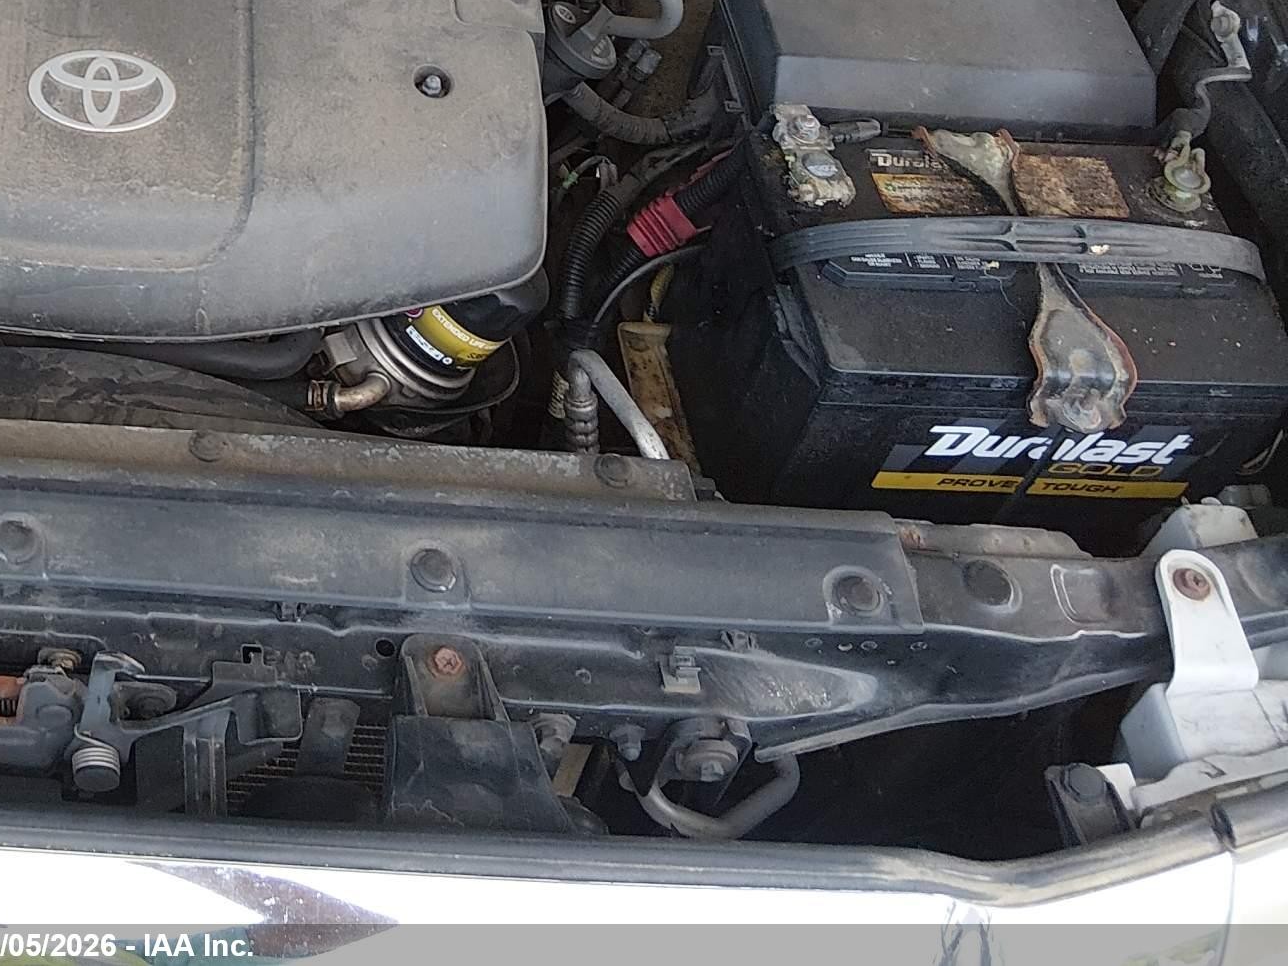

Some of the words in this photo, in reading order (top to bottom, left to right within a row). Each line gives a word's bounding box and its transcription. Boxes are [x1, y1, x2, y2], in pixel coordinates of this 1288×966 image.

[871, 153, 948, 172] Durala
[1047, 463, 1164, 477] GOLD
[937, 478, 1019, 489] PROVE
[1041, 482, 1121, 494] TOUGH
